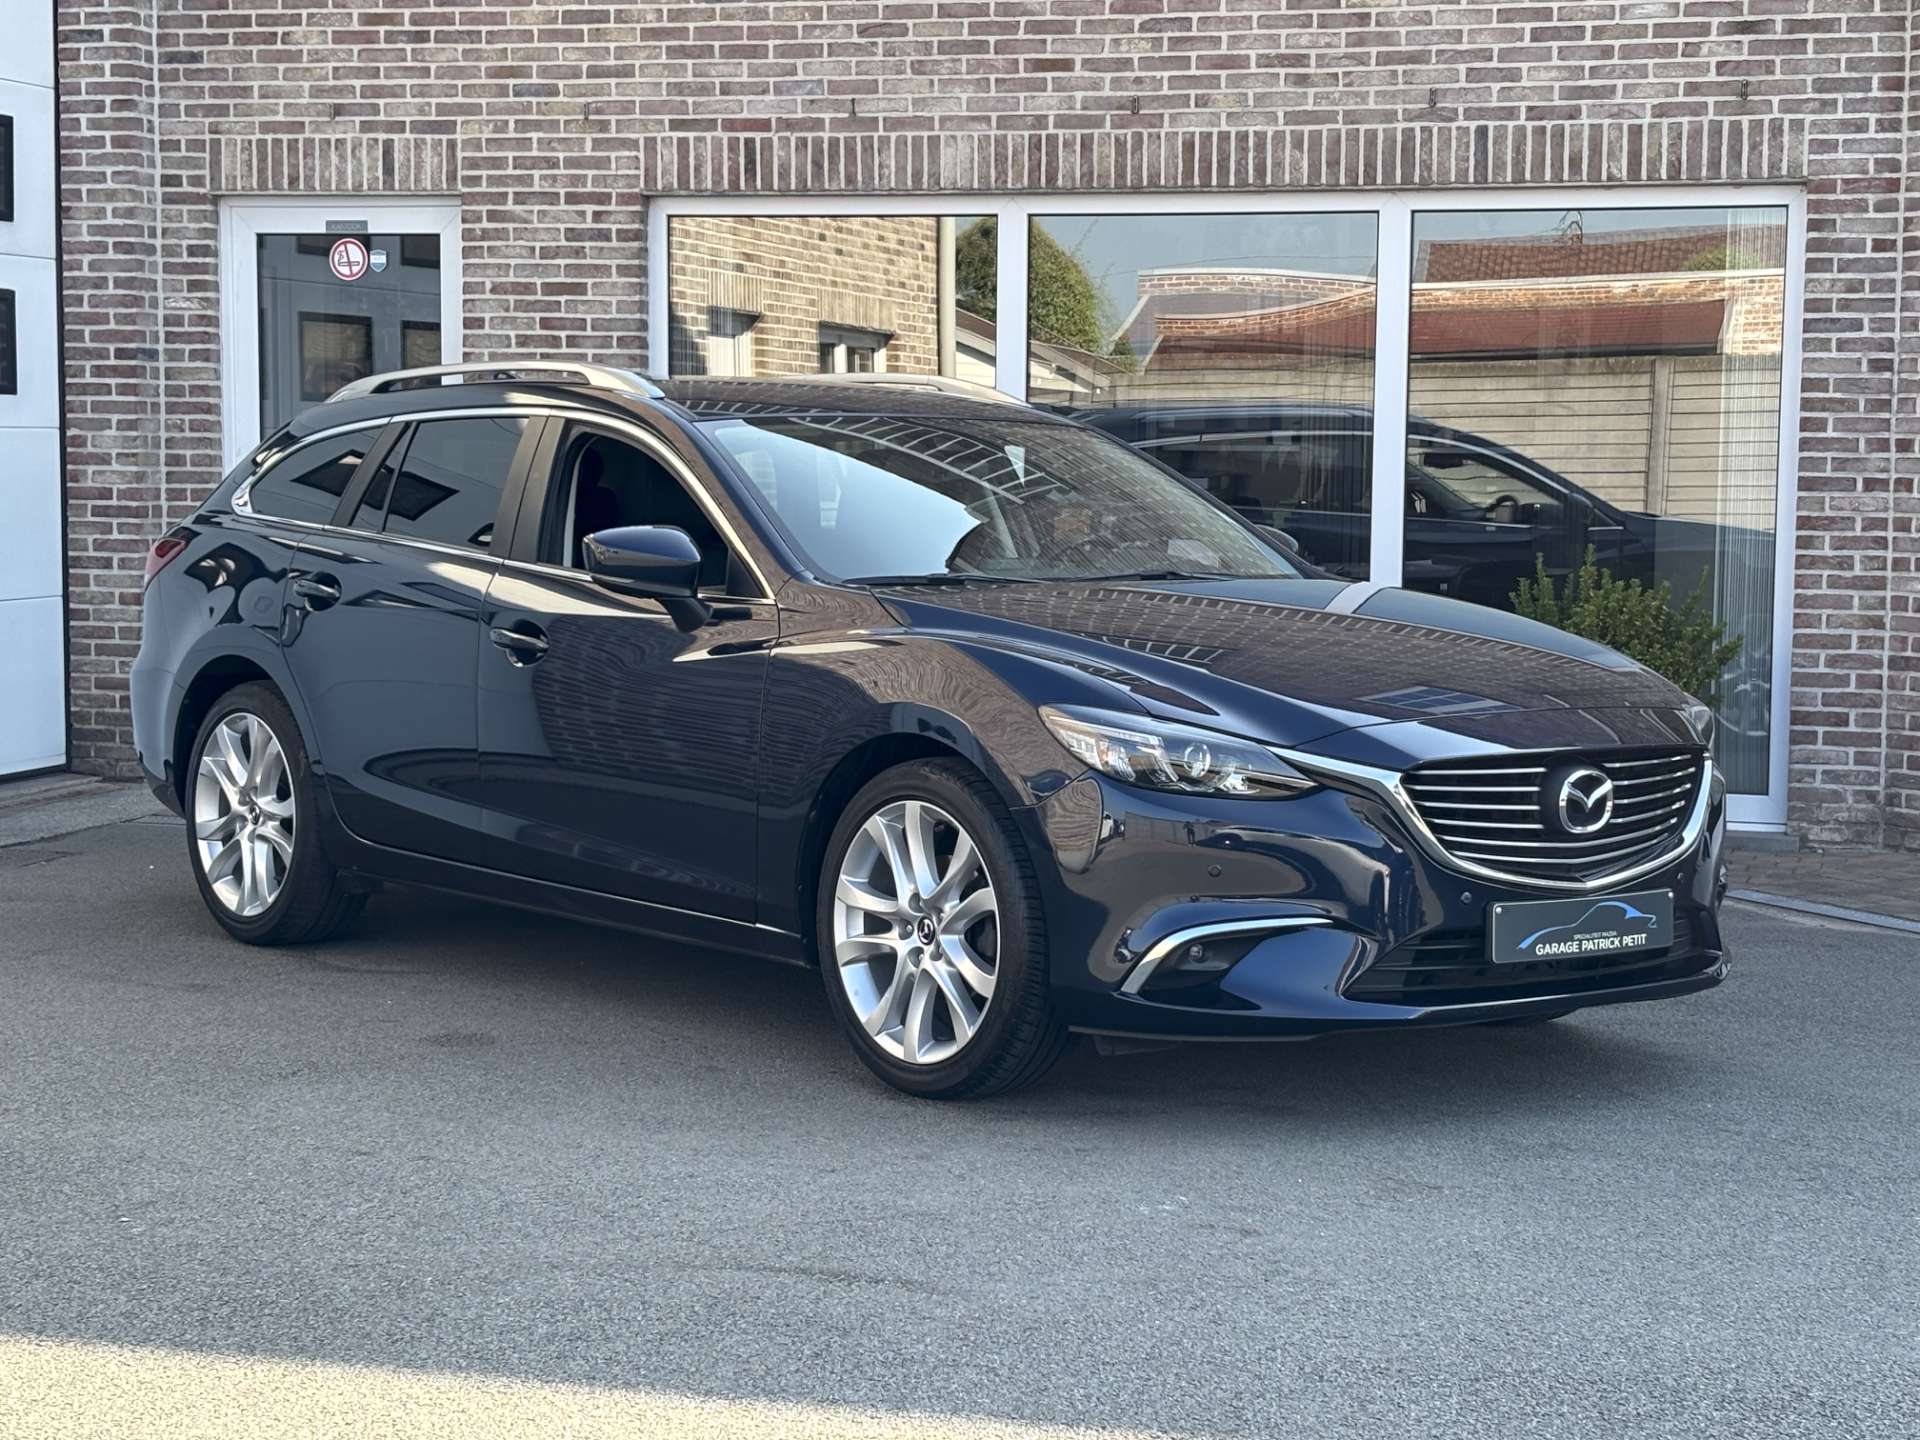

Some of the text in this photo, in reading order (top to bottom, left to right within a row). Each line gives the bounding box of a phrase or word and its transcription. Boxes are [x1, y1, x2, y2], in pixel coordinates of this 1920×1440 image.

[1536, 934, 1647, 955] GARAGE PATRICK PETIT
